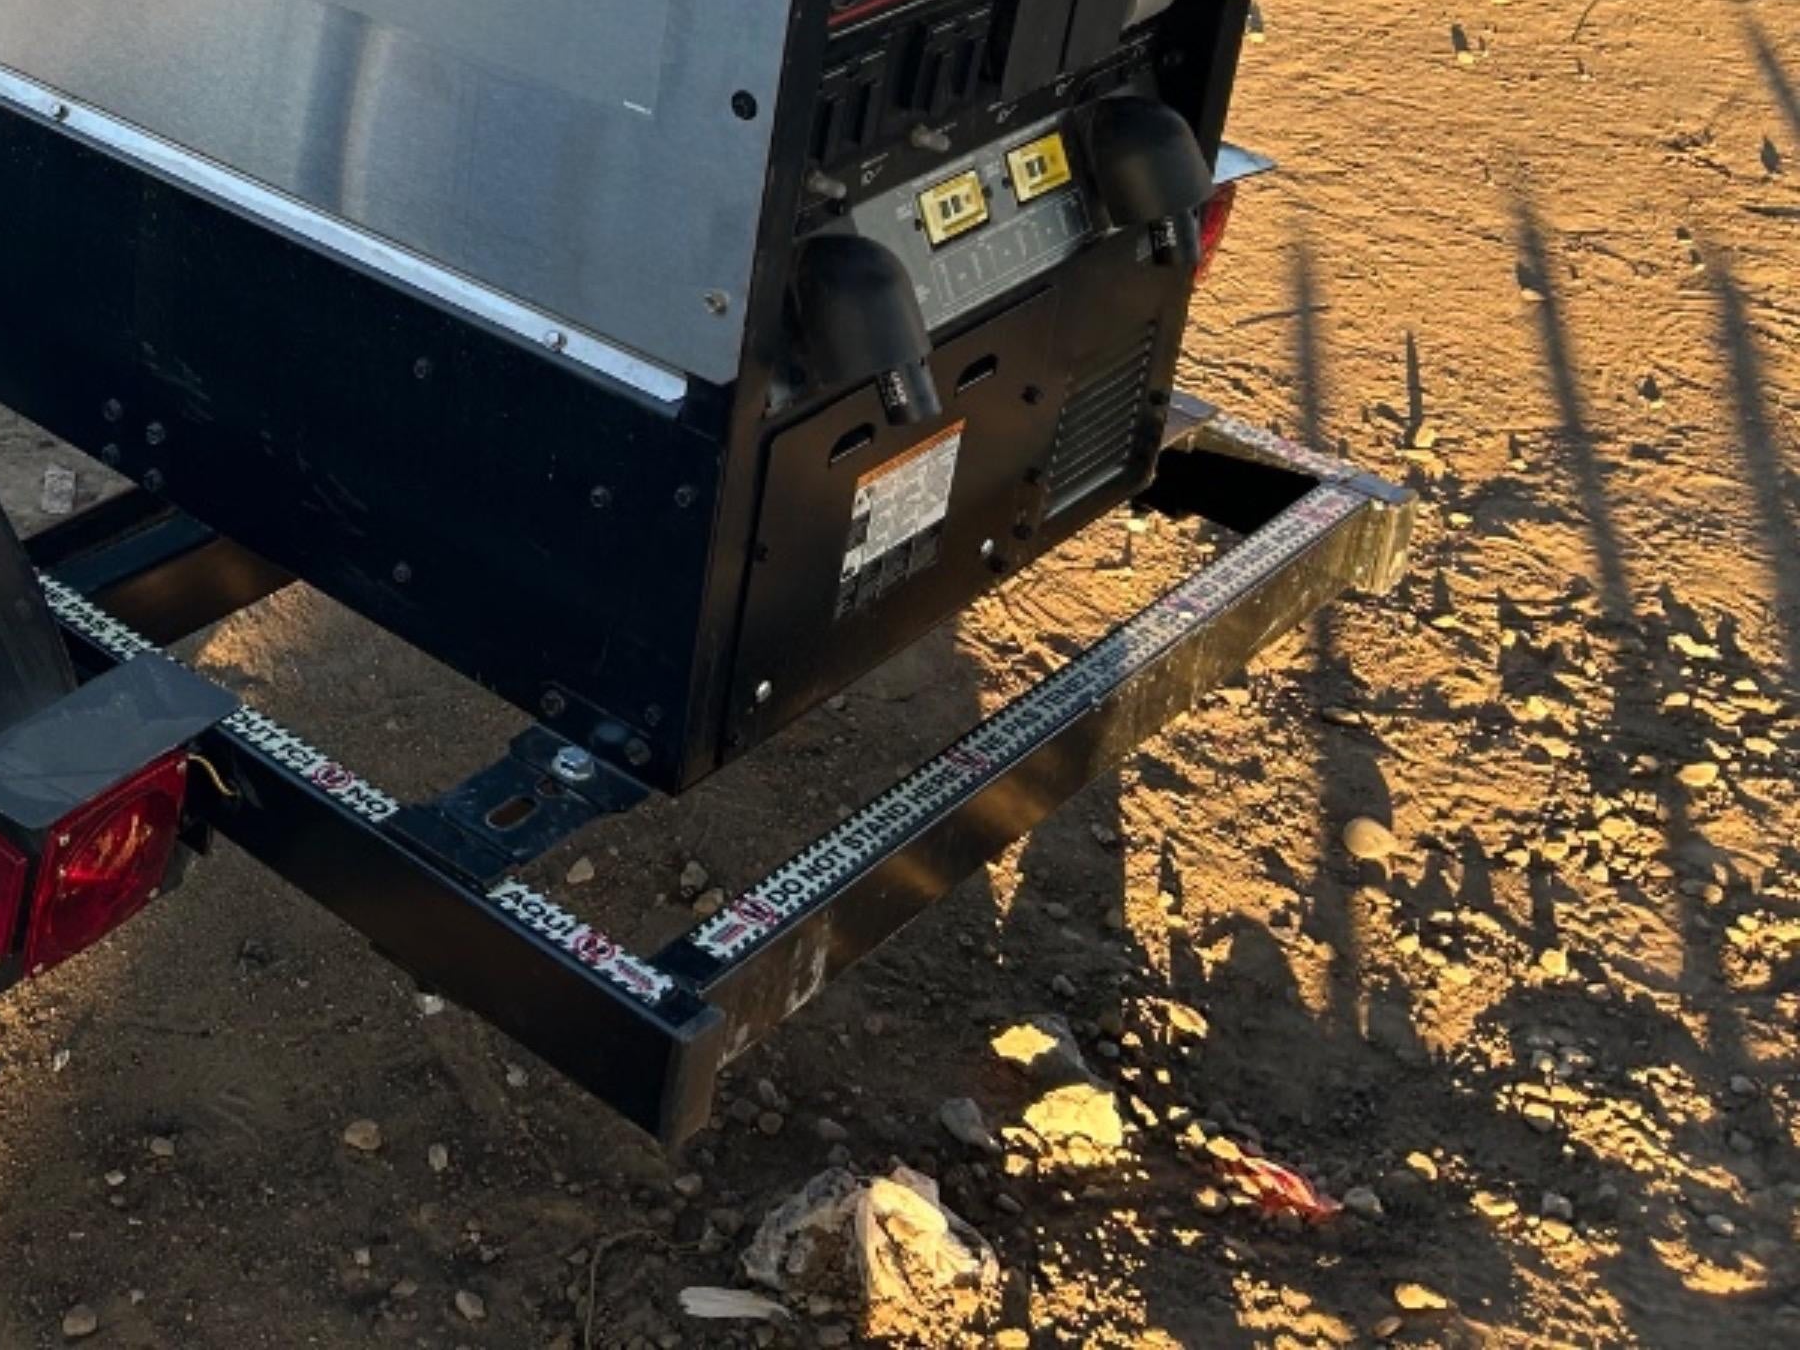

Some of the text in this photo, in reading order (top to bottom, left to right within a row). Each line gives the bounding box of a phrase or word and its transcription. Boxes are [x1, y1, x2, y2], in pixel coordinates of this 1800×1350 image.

[344, 785, 390, 815] NO
[767, 877, 805, 907] DO
[803, 846, 851, 880] NOT
[843, 802, 913, 849] STAND
[909, 766, 964, 804] HERE
[1003, 707, 1044, 736] PAS
[1038, 671, 1096, 710] TENEZ
[499, 888, 576, 937] AQUI
